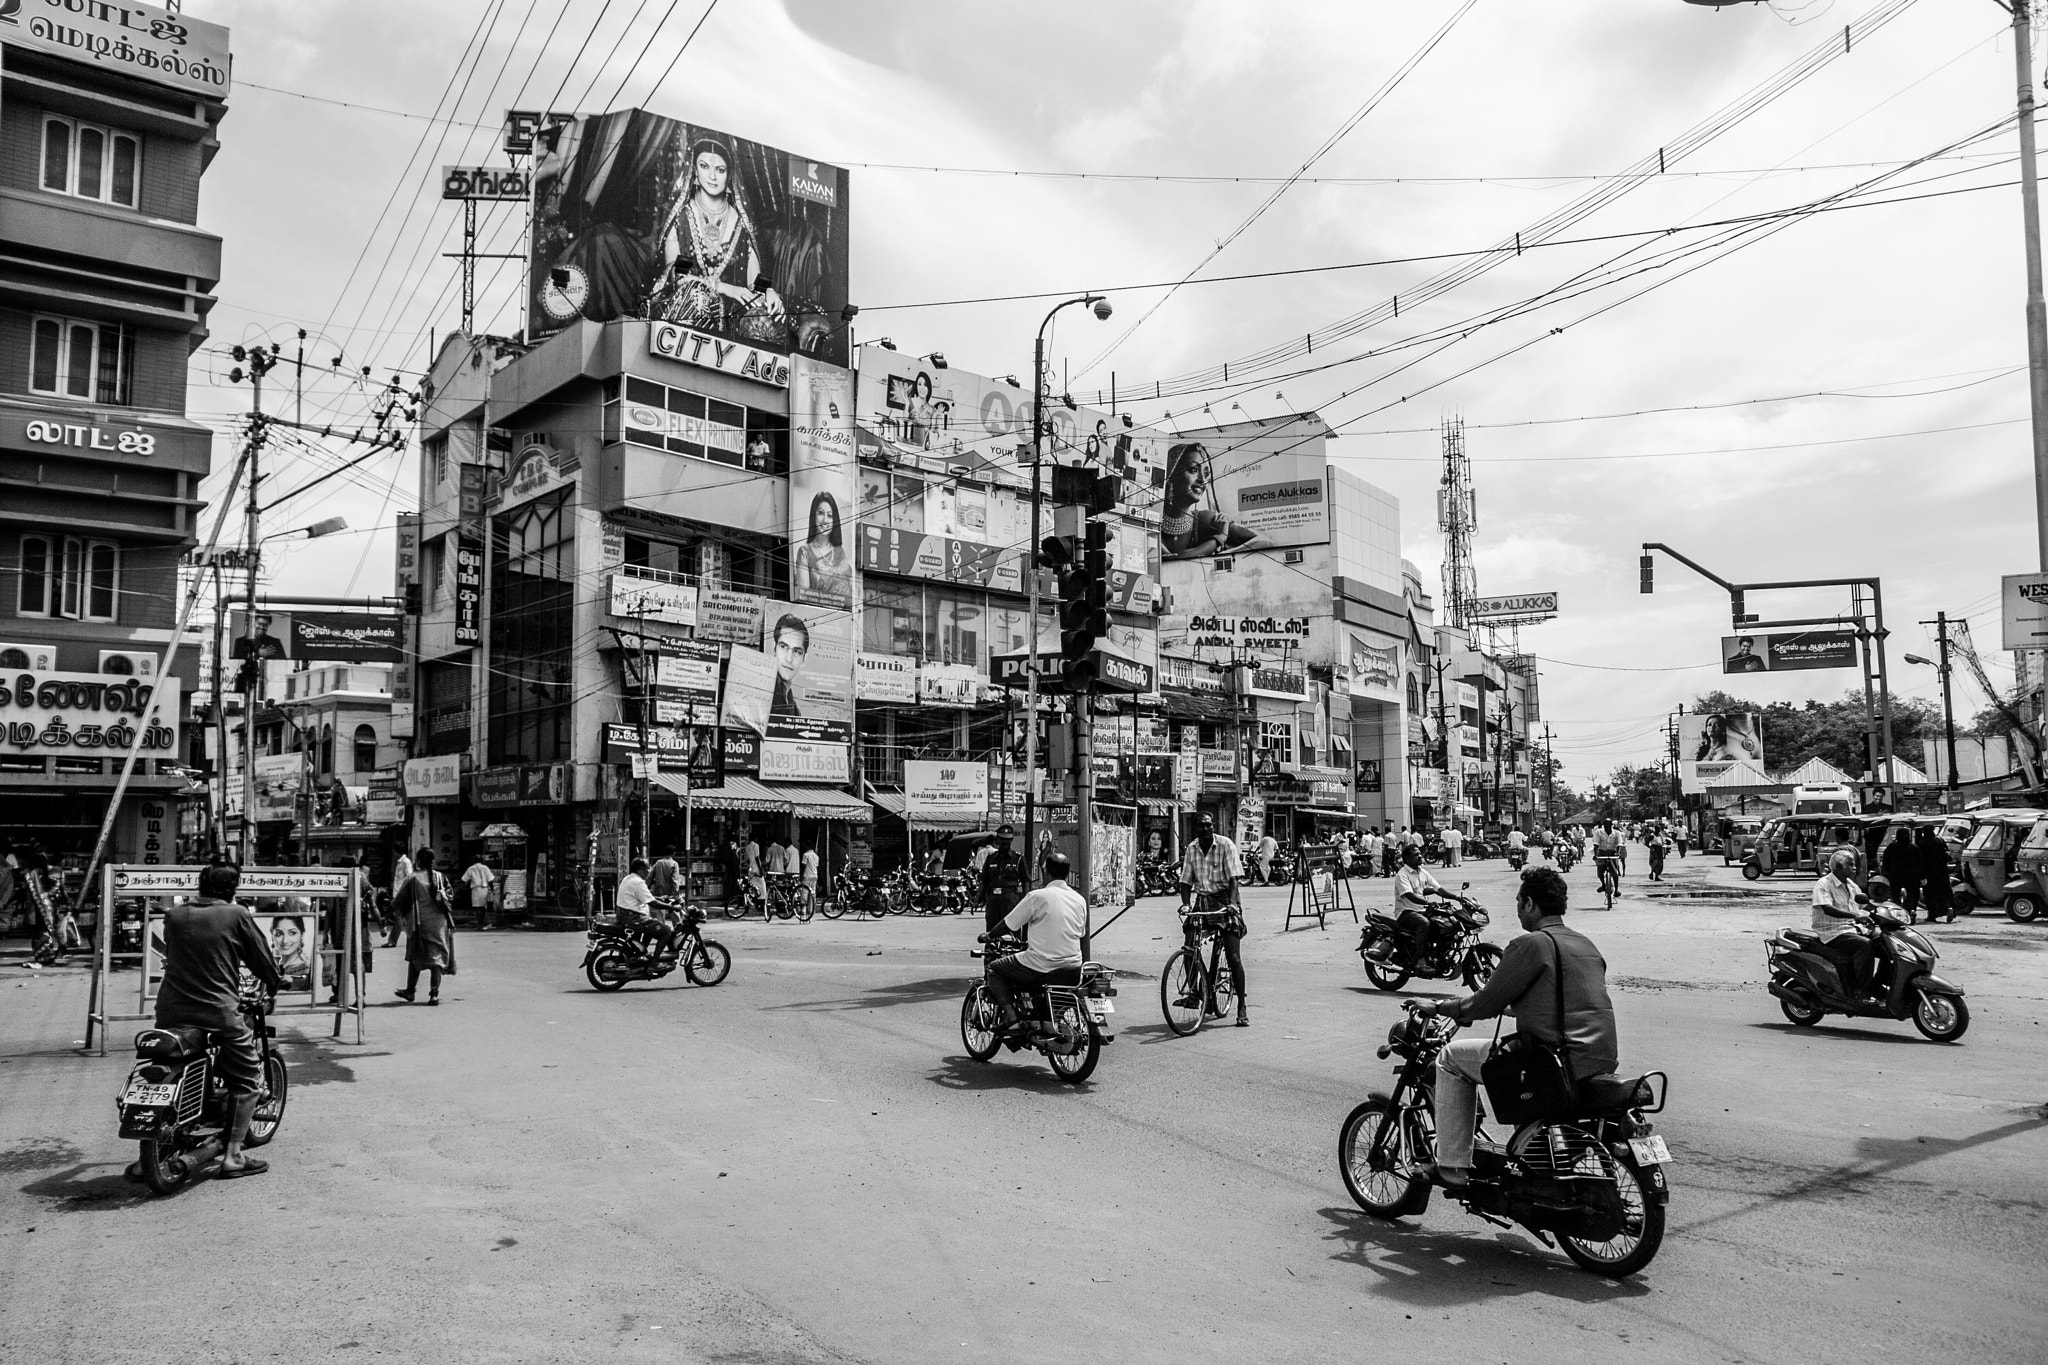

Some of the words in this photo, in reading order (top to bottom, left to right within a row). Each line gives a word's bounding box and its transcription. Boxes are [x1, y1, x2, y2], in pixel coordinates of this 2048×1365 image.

[29, 15, 225, 86] மெடிக்கல்ஸ்
[792, 176, 833, 198] KALYAN
[656, 325, 736, 368] CITY
[741, 350, 790, 385] Ads
[26, 420, 156, 456] லாட்ஜ்
[670, 414, 703, 443] FLEX
[708, 422, 744, 453] PRINTING
[990, 446, 1013, 458] YOUR
[1241, 490, 1276, 504] Francis
[1278, 486, 1319, 499] Alukkas
[920, 555, 942, 566] V-GUARD
[716, 602, 760, 615] COMPUTERS
[1503, 596, 1553, 611] ALUKKAS
[298, 624, 330, 638] ஜோஸ்
[342, 627, 395, 640] ஆலுக்காஸ்
[1189, 615, 1235, 635] அன்பு
[1240, 616, 1302, 634] ஸ்வீட்ஸ்
[1244, 637, 1299, 648] SWEETS
[1773, 642, 1799, 654] ஜோஸ்
[1807, 640, 1851, 652] ஆலுக்காஸ்
[1002, 658, 1064, 678] POLI
[1105, 659, 1148, 687] காவல்
[0, 715, 174, 751] டிக்கல்ஸ்
[762, 747, 847, 772] ஜெராக்ஸ்
[433, 766, 458, 785] கடை
[939, 768, 956, 781] 149
[732, 799, 783, 810] MEDICALS
[130, 873, 191, 887] தஞ்சாவூர்
[308, 875, 344, 887] காவல்
[136, 1084, 169, 1092] TN-49
